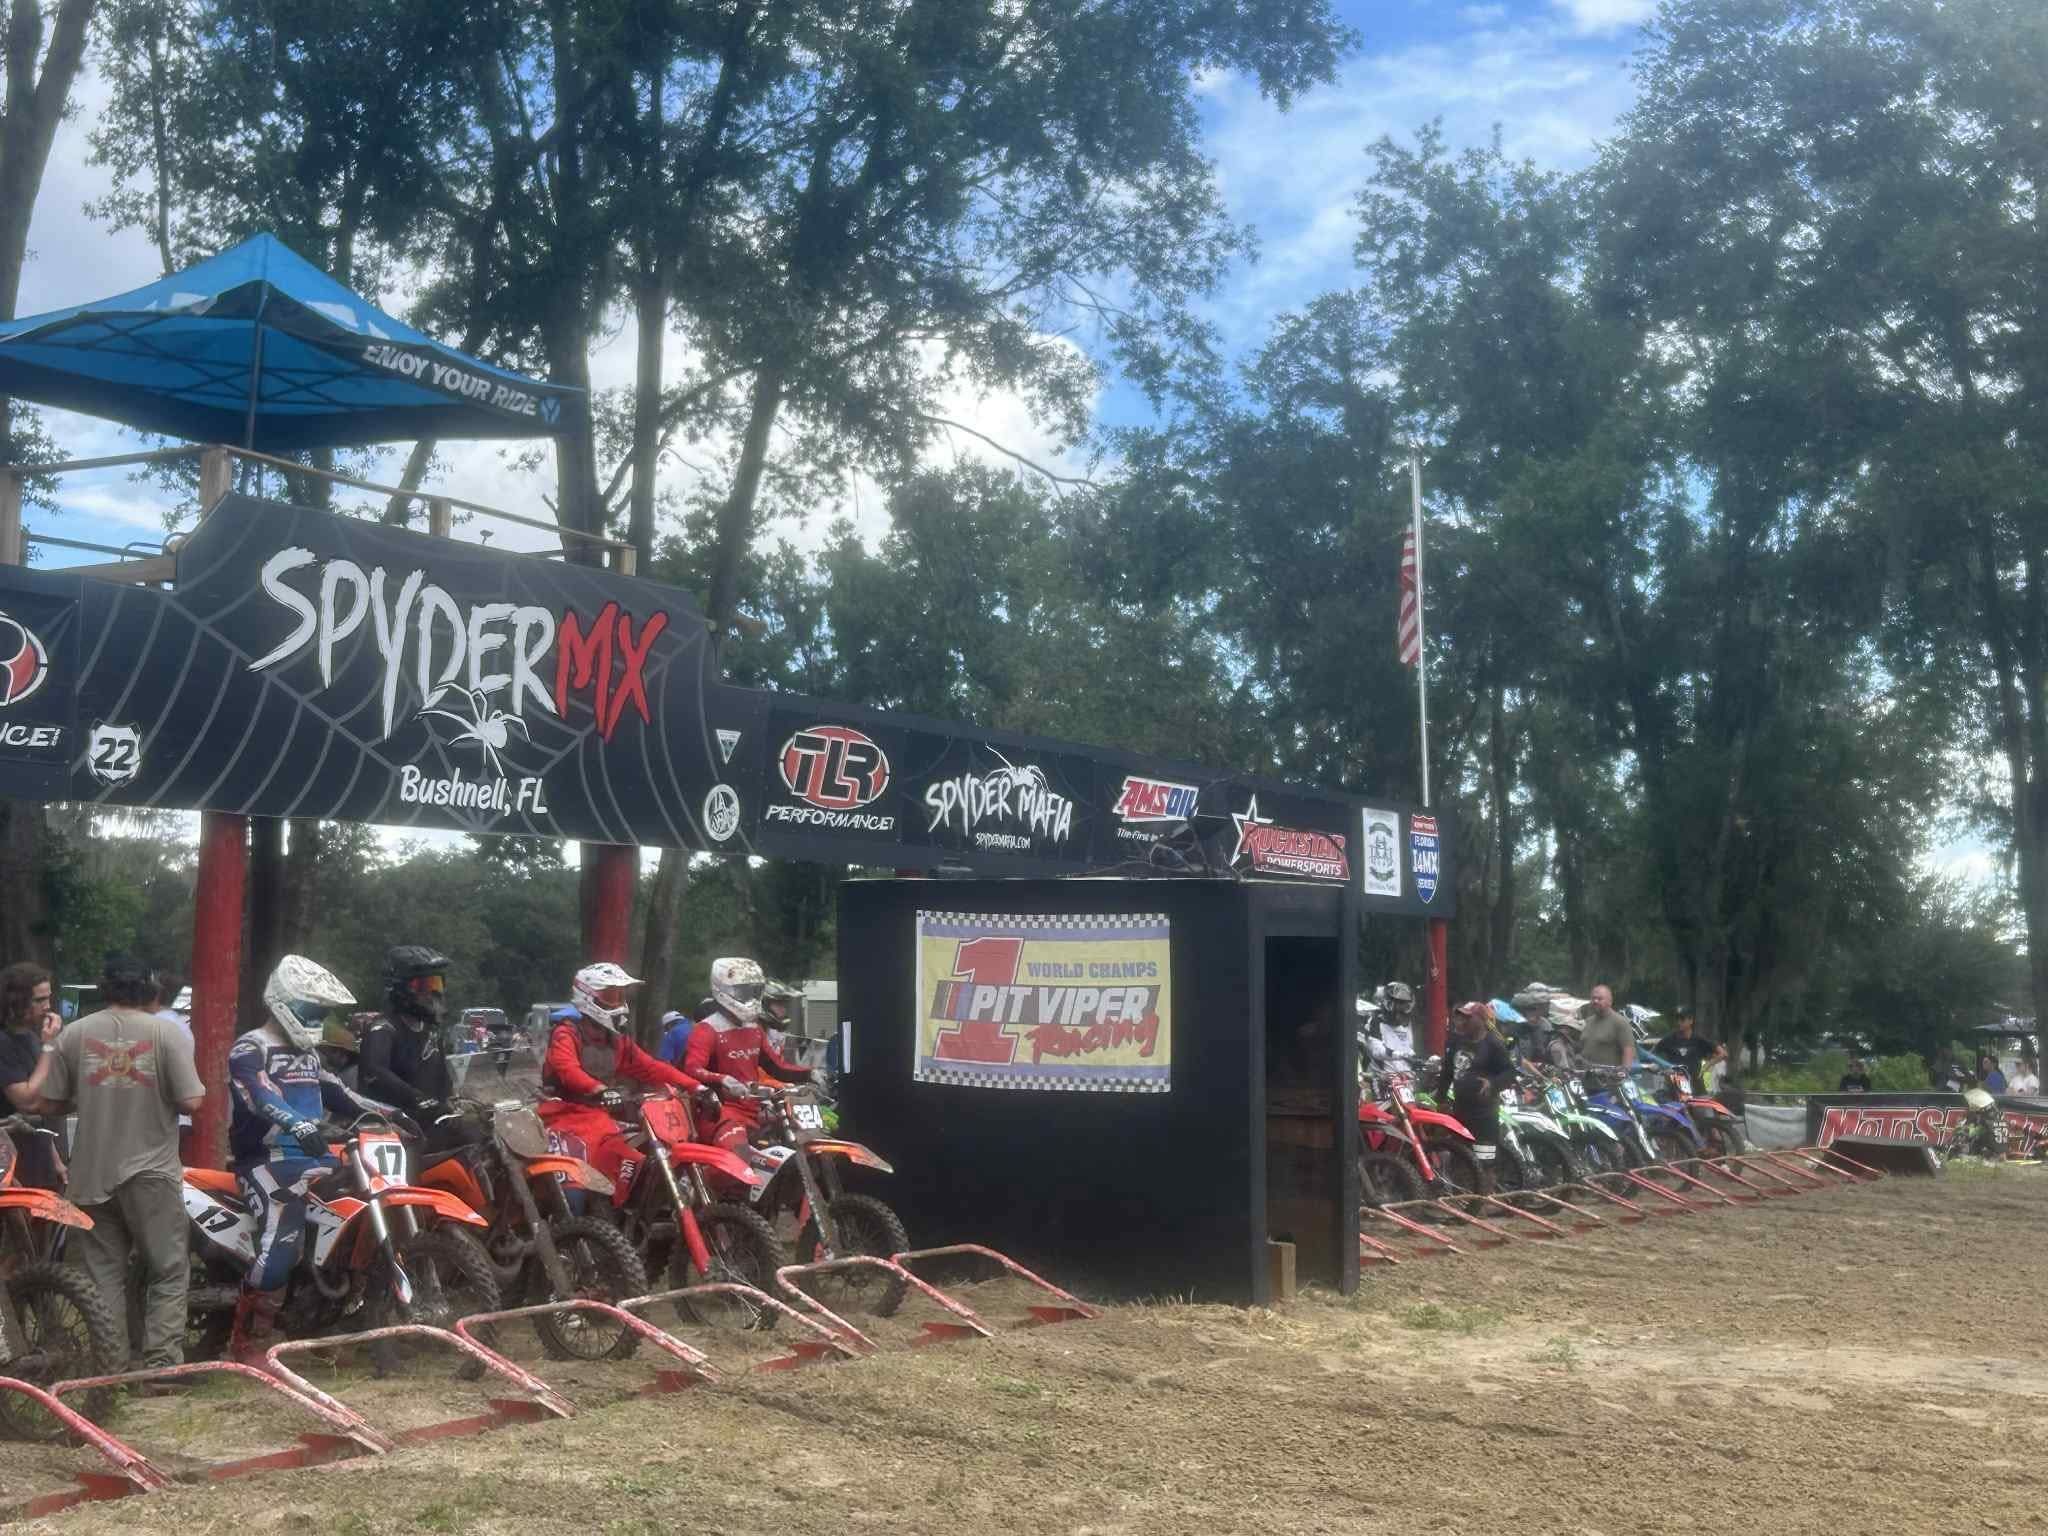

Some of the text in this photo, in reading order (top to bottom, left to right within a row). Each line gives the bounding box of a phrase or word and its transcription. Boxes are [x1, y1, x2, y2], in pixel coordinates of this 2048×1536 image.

[361, 345, 540, 416] ENJOY YOUR RIDE
[94, 737, 136, 771] 22
[792, 731, 881, 804] TLR
[516, 777, 549, 814] FL
[925, 773, 1073, 843] SPYDER MAFIA
[1116, 778, 1198, 819] AMSOIL
[1266, 855, 1342, 876] POWERSPORTS
[1027, 961, 1158, 978] WORLD CHAMPS
[968, 985, 1151, 1026] PIT VIPER
[374, 1145, 402, 1176] 17
